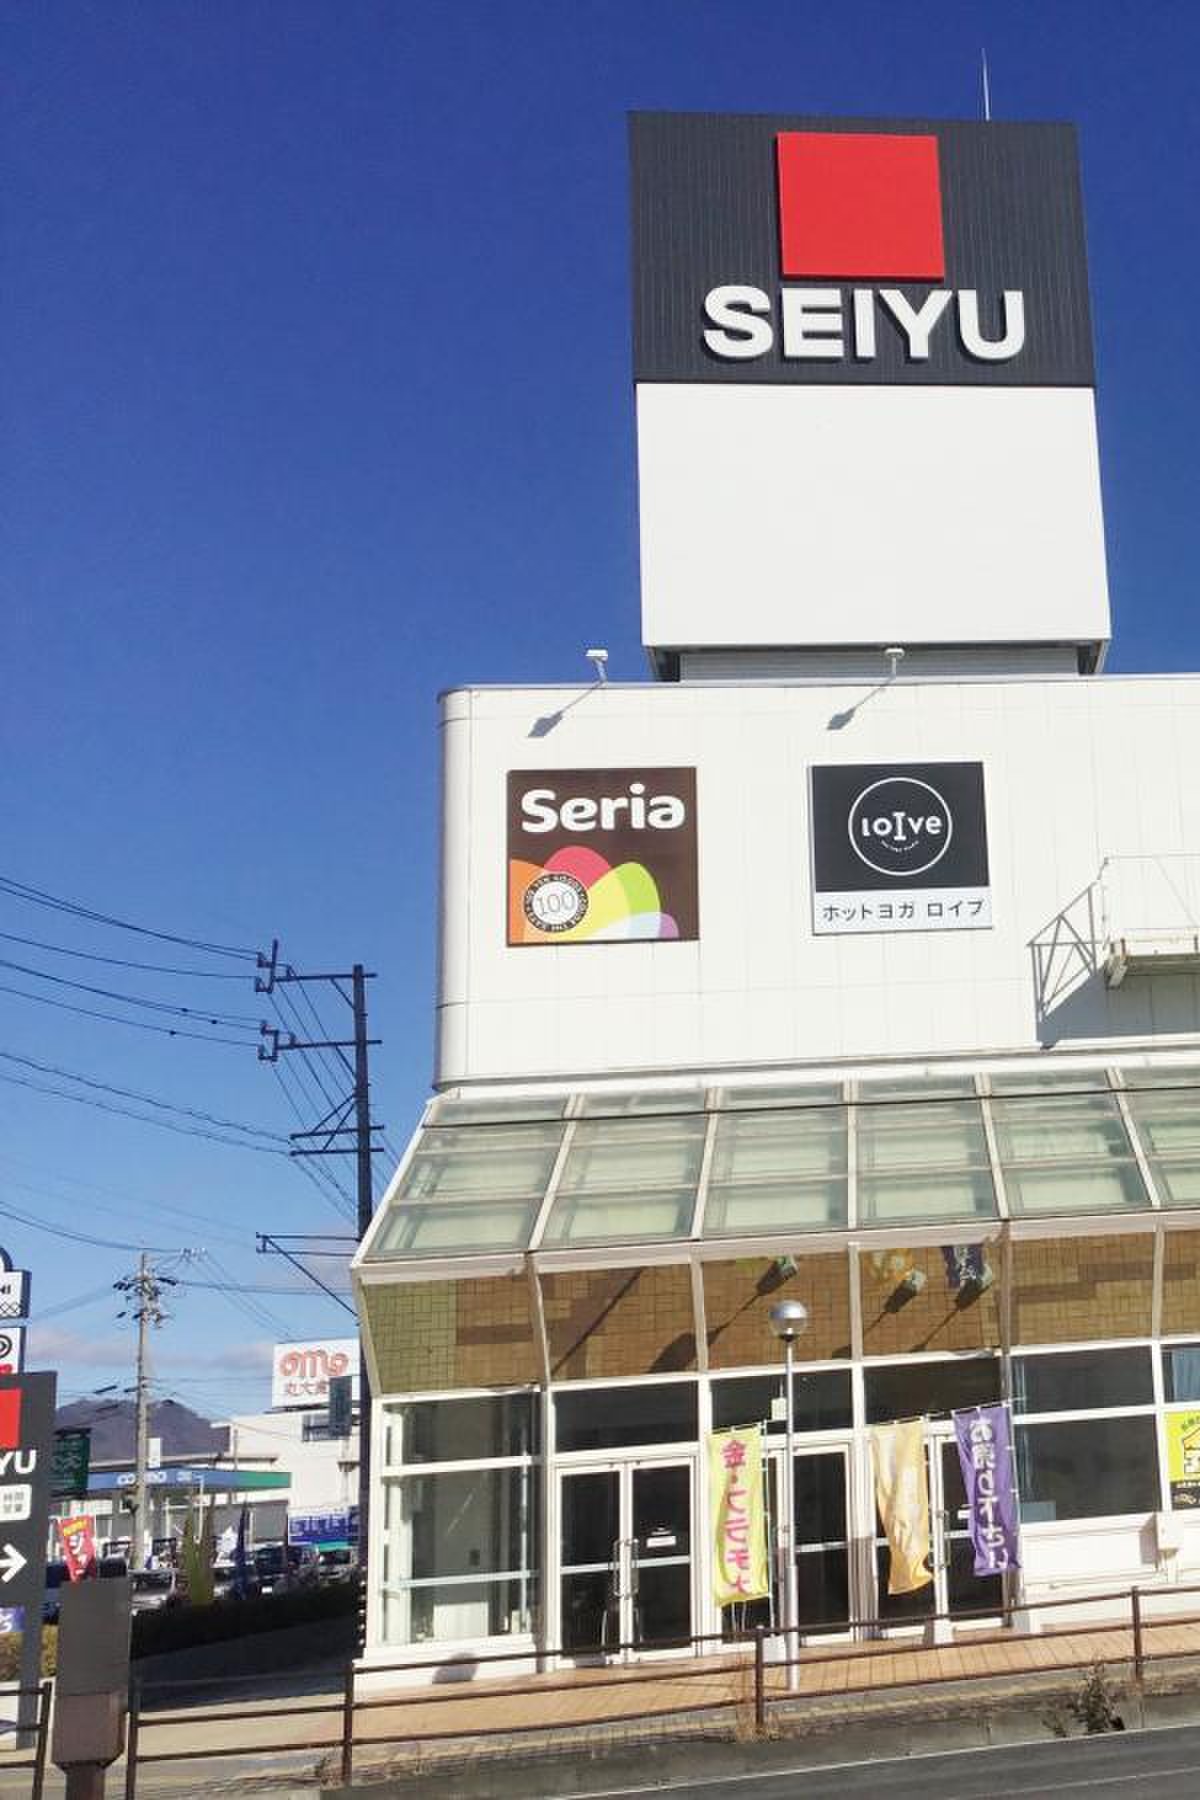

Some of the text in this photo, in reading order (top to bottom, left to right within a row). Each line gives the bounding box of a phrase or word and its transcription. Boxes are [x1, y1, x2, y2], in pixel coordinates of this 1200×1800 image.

[703, 284, 1026, 360] SEIYU
[521, 783, 685, 833] Seria
[538, 891, 577, 917] 100
[823, 902, 914, 922] ホットヨガ
